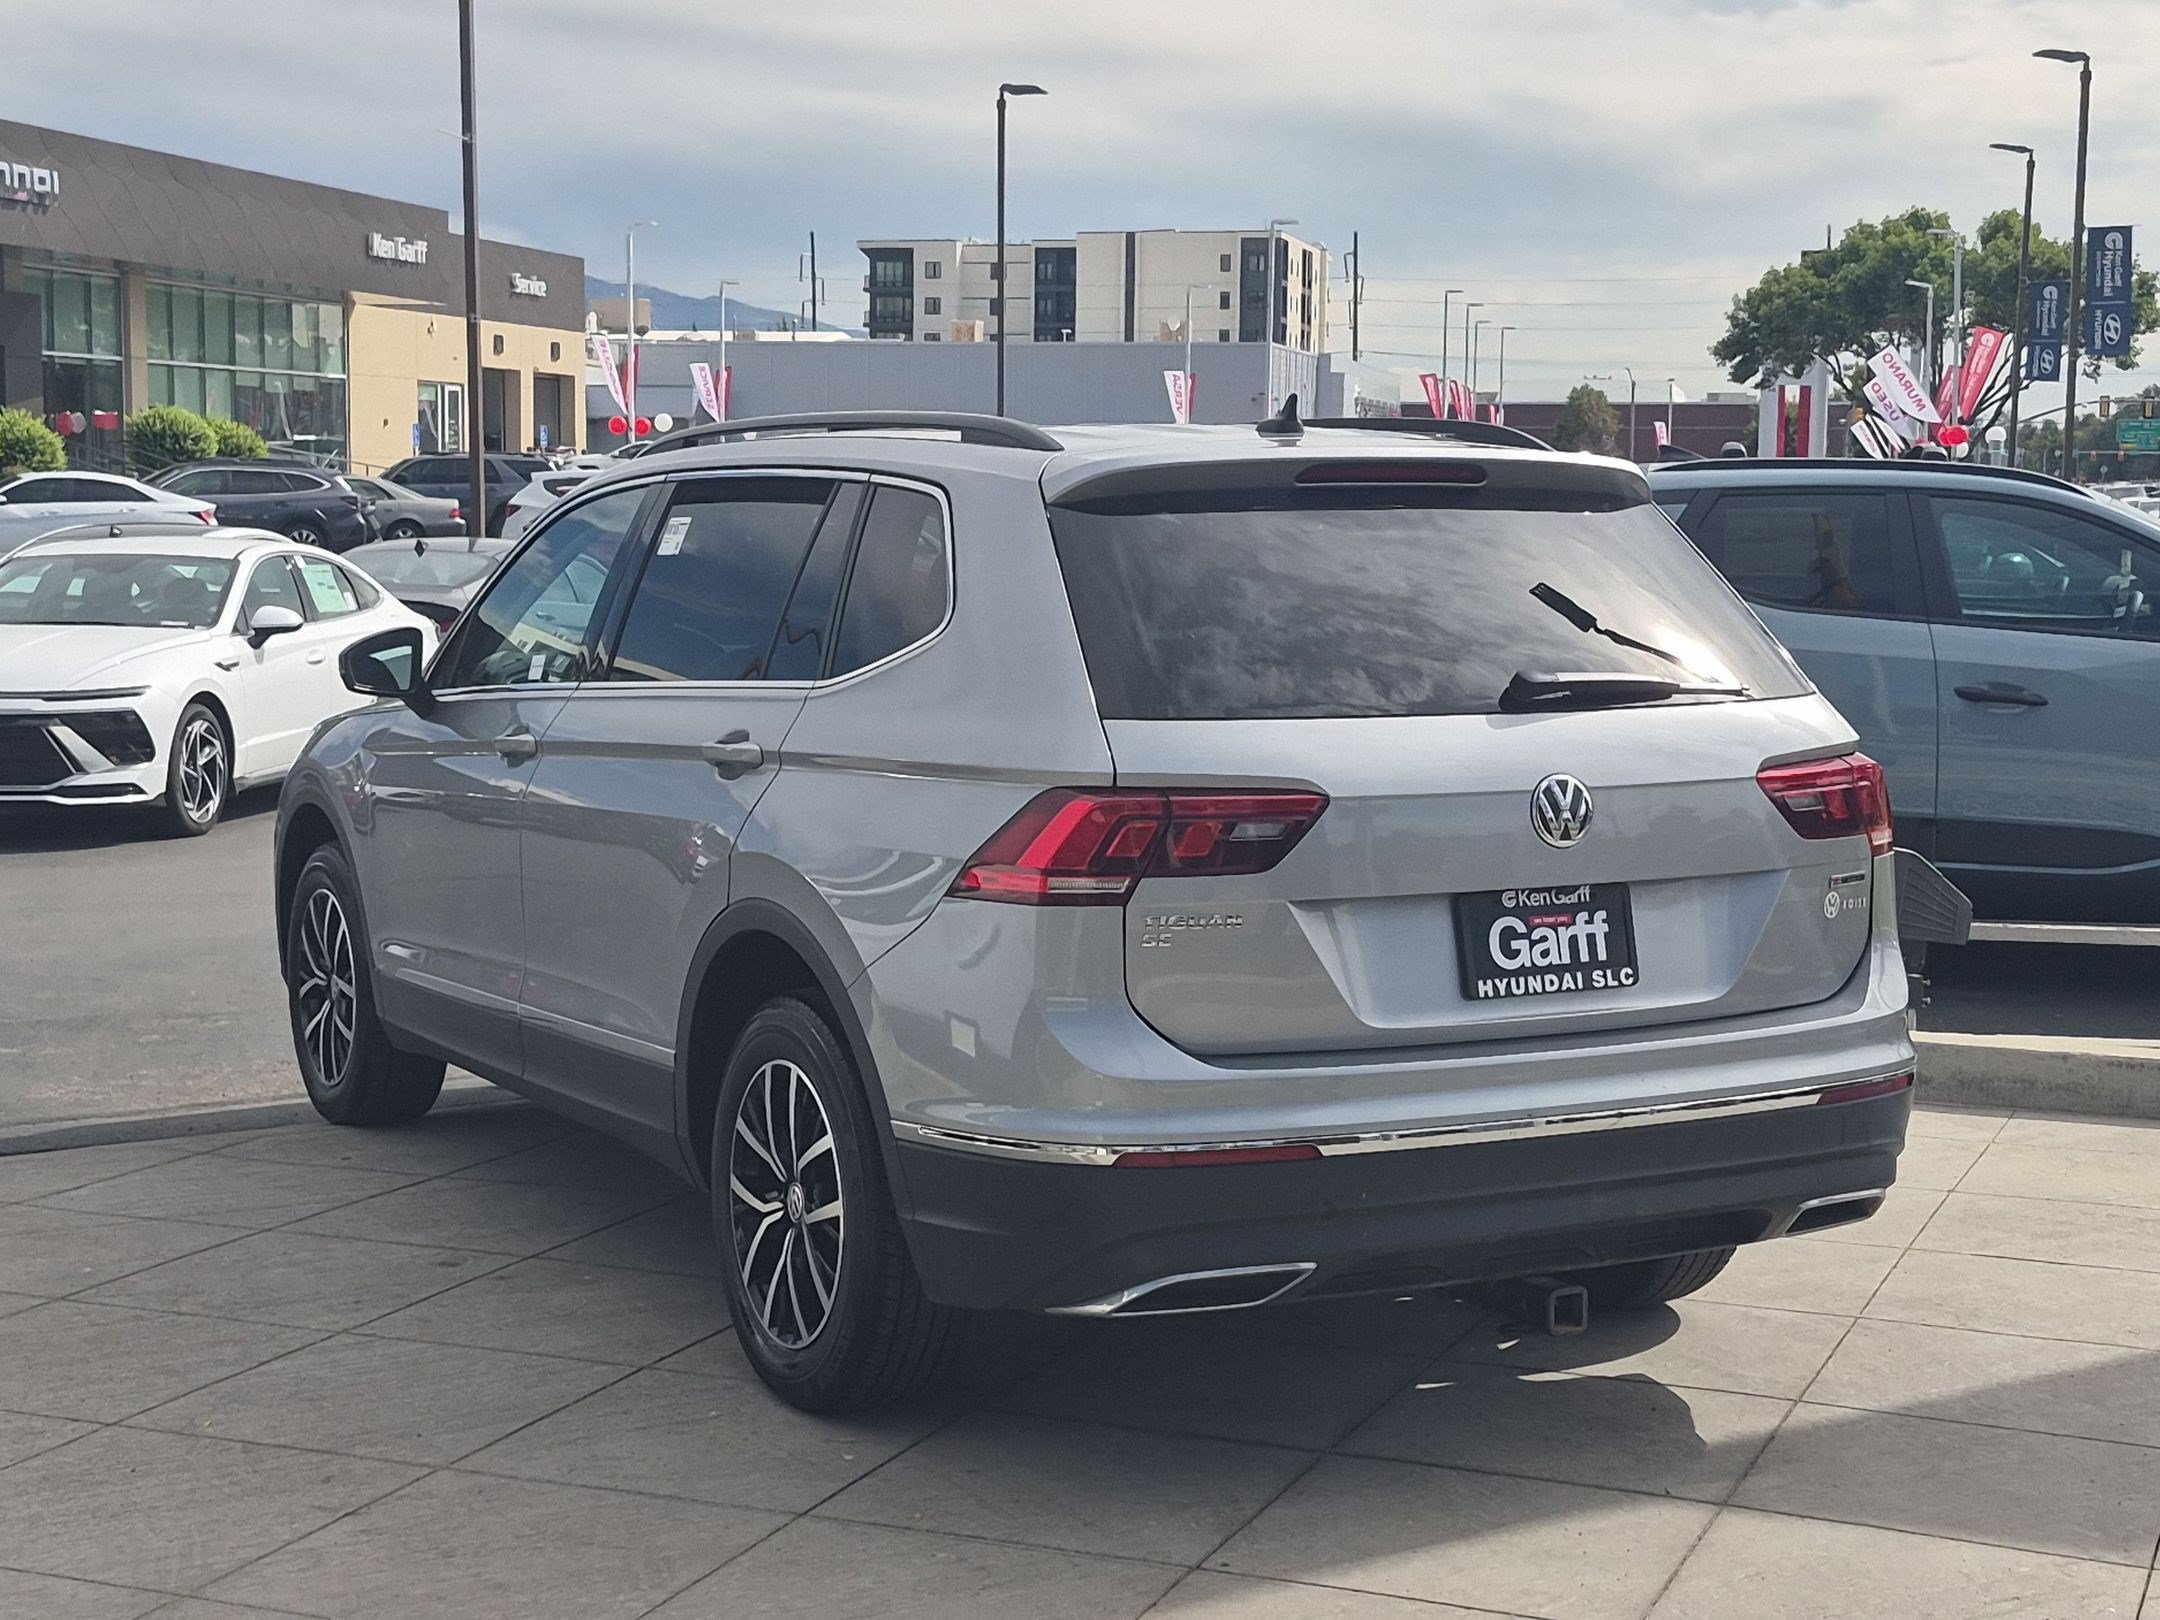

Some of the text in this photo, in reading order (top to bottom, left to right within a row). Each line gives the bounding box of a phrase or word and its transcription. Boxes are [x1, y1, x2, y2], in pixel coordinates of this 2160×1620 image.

[368, 232, 395, 259] Ken
[511, 272, 547, 297] Service
[2102, 250, 2114, 297] Hyundai
[1518, 885, 1591, 907] Ken Garff
[1144, 914, 1243, 931] TIGUAN
[1141, 933, 1173, 948] SE
[1488, 910, 1610, 971] Garff
[1477, 967, 1634, 998] HYUNDAI SLC
